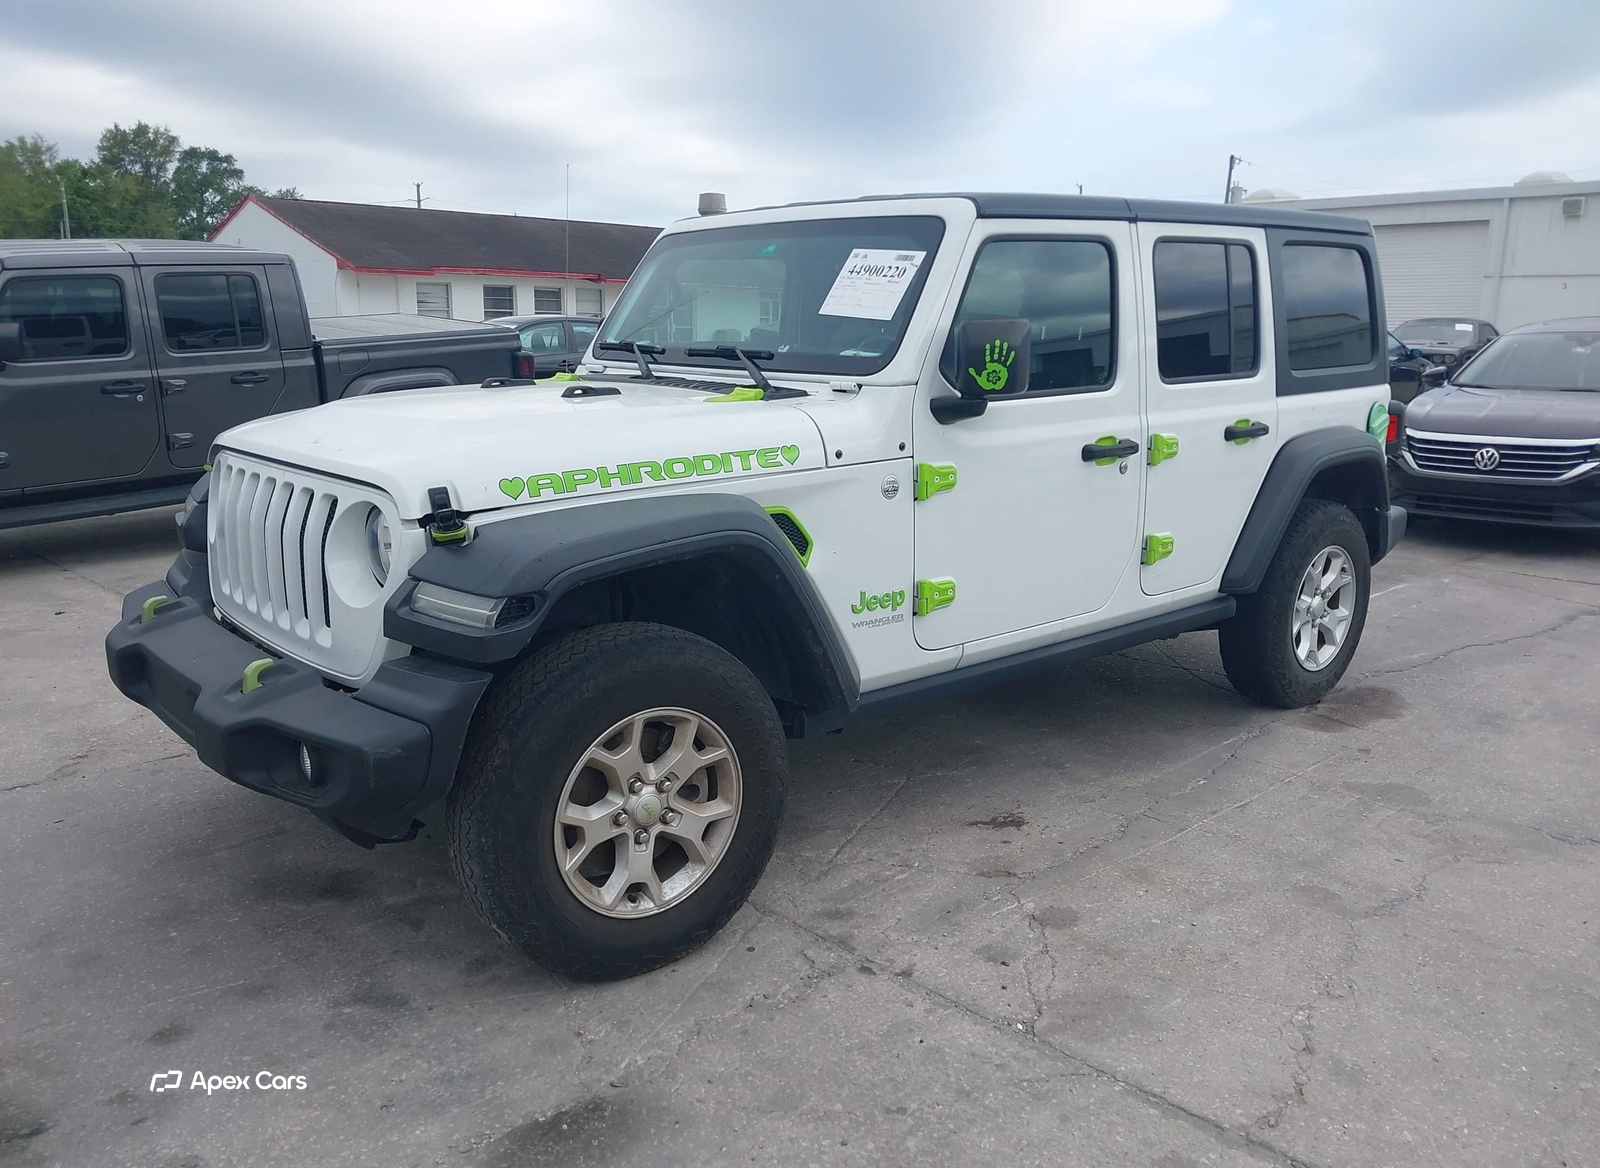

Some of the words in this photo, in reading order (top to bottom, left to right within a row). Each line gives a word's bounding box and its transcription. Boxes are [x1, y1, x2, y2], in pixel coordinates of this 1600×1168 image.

[848, 264, 907, 278] 44900220
[527, 446, 784, 497] APHRODITE
[851, 588, 906, 614] Jeep
[851, 613, 904, 629] WRANGLER
